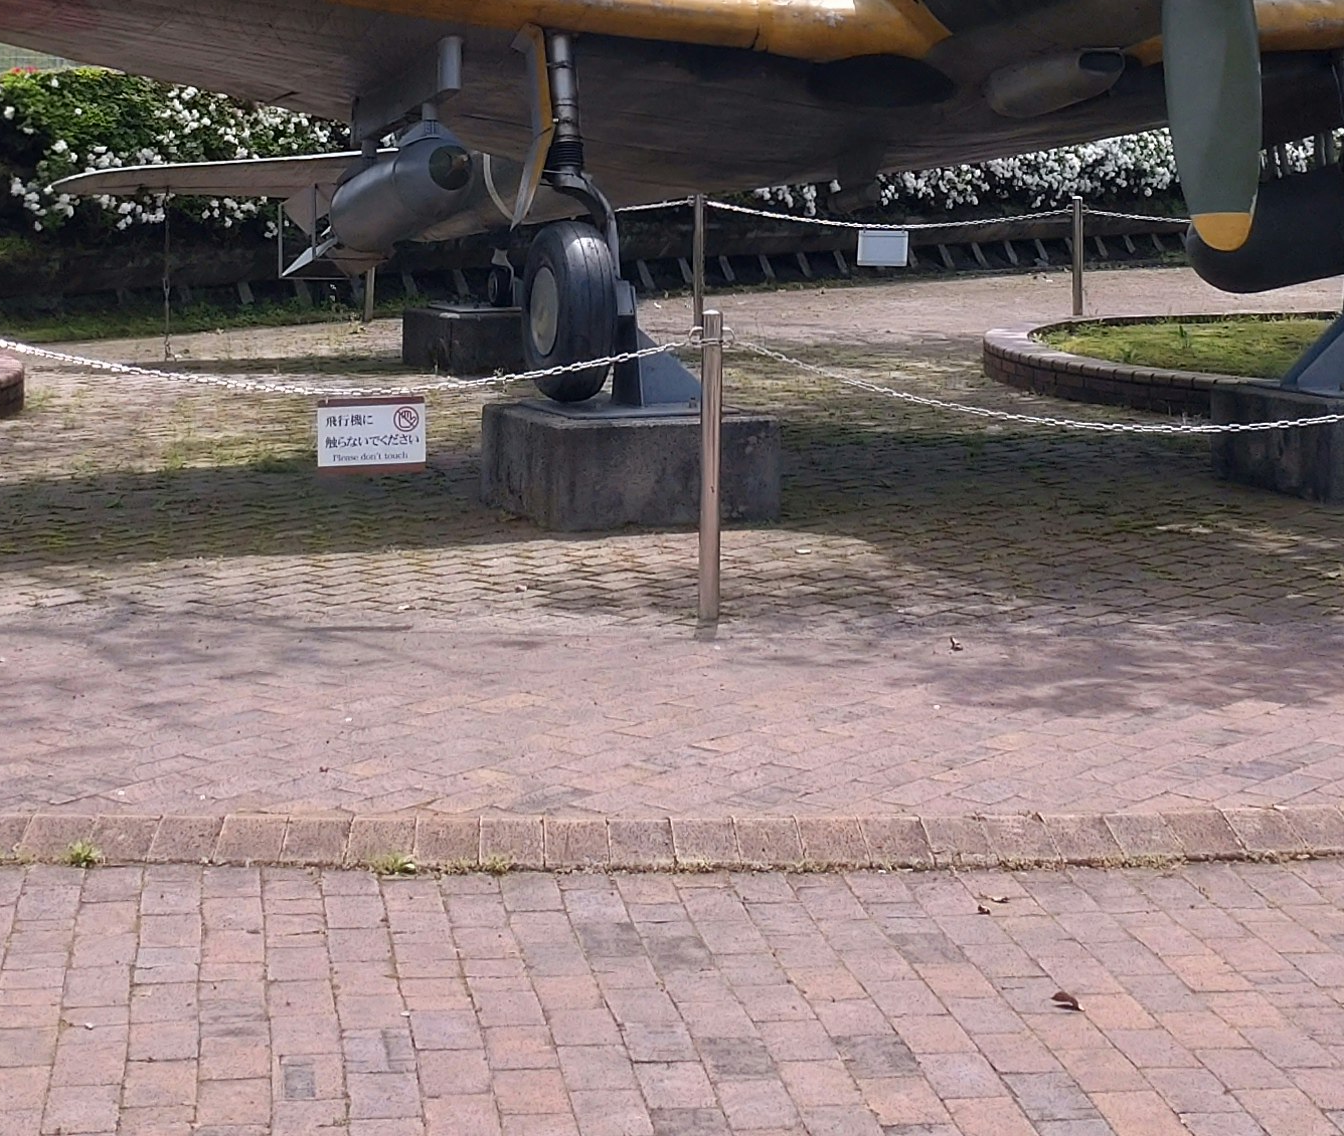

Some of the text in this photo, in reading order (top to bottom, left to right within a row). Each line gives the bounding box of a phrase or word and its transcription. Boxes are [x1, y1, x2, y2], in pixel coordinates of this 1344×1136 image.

[325, 413, 374, 428] 飛行機に
[325, 433, 420, 449] 触らないでください
[332, 451, 409, 462] Please don't touch
